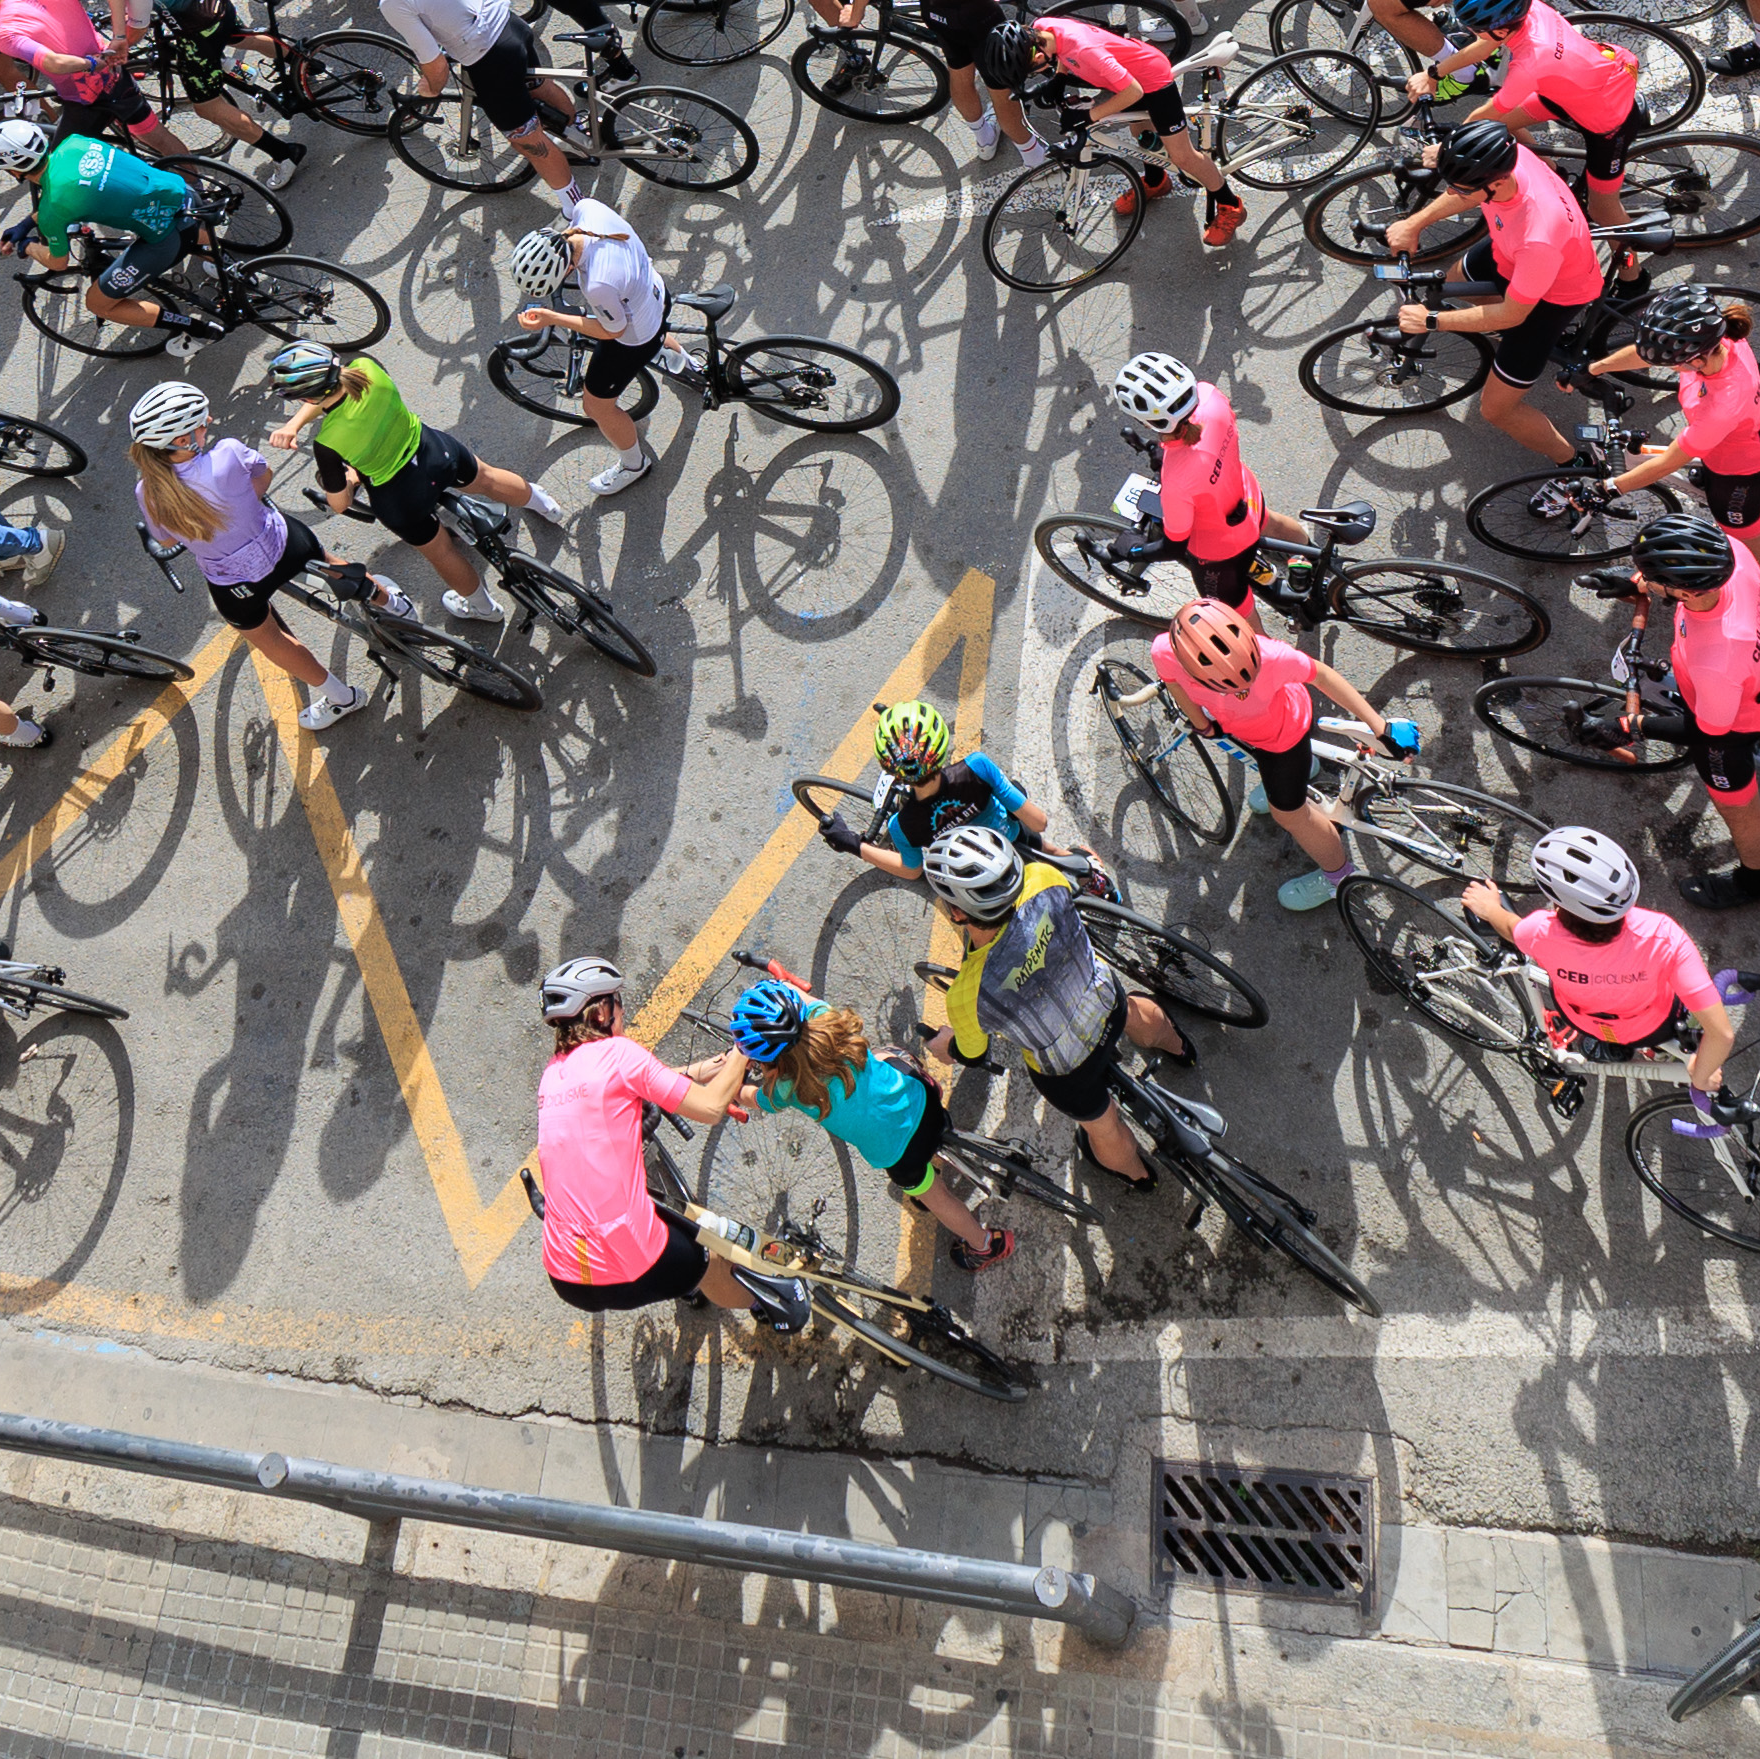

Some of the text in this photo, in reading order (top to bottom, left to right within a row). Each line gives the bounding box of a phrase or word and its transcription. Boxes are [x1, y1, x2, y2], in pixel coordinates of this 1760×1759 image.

[1210, 459, 1226, 486] CEB
[1557, 969, 1649, 985] CEB CICLISME
